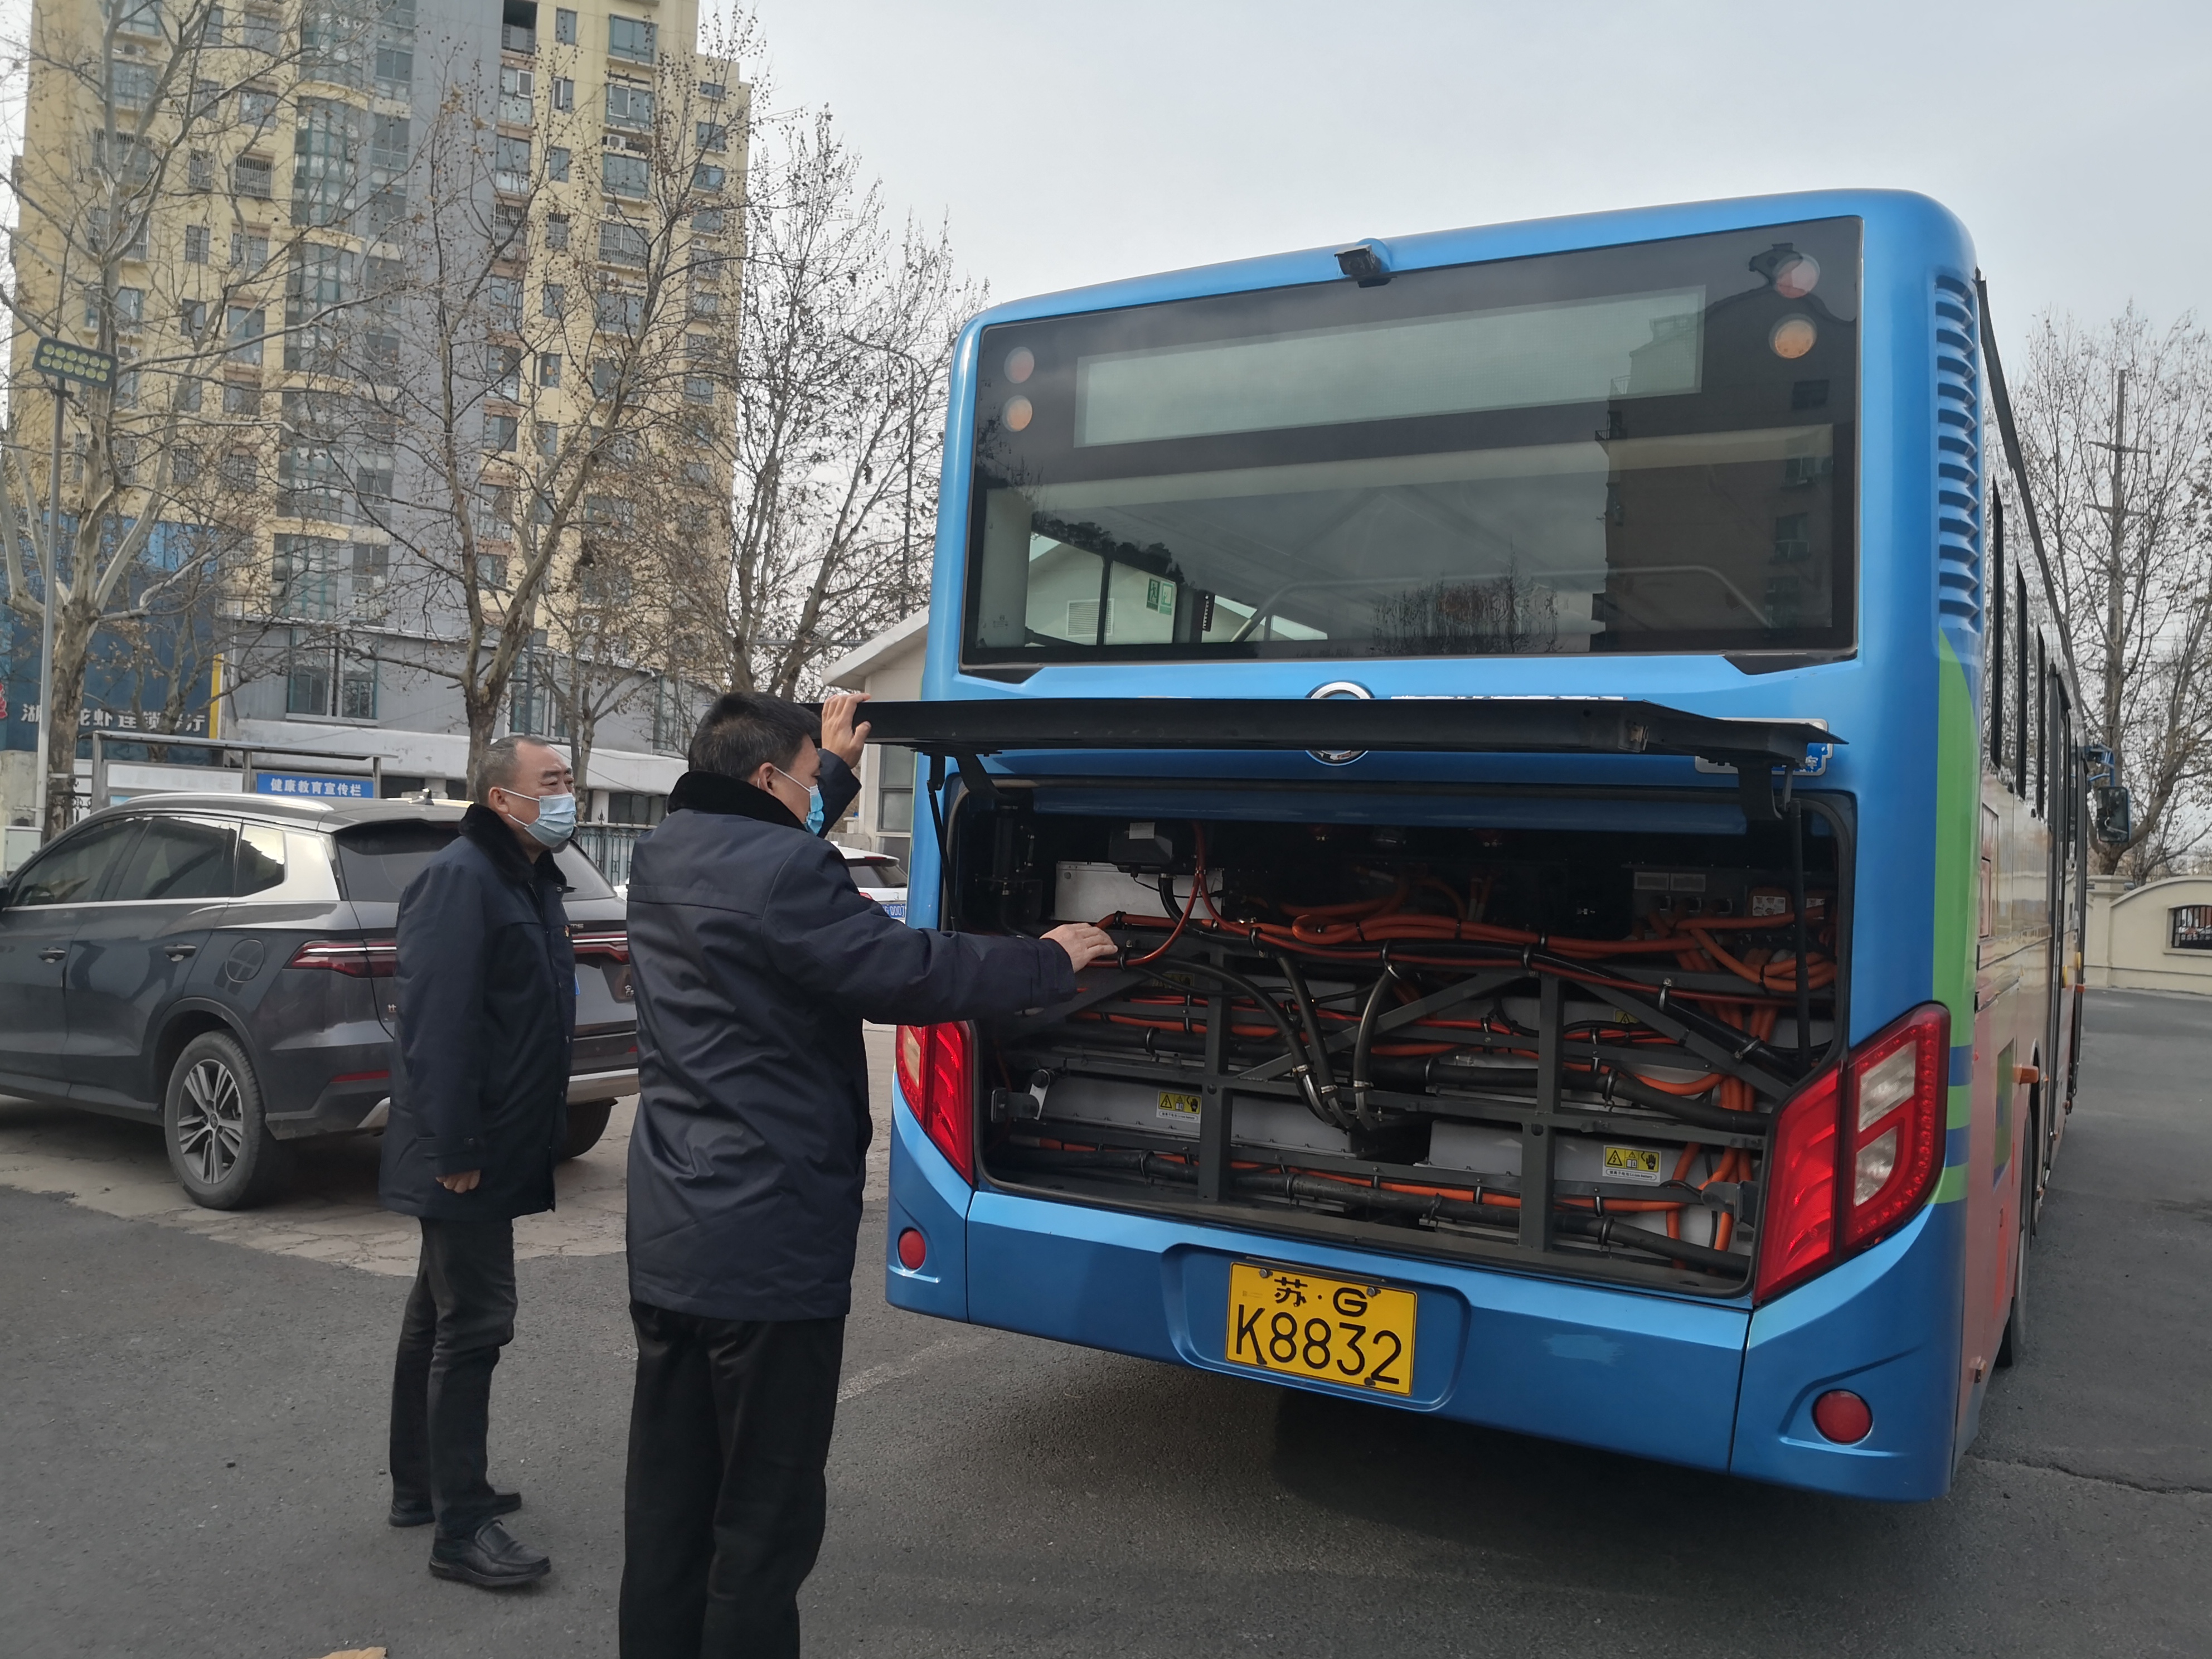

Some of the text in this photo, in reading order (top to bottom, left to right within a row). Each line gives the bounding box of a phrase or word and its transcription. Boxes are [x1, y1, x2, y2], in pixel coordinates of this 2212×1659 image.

[271, 778, 361, 796] 健康教育宣传栏
[1236, 1304, 1402, 1385] K8832
